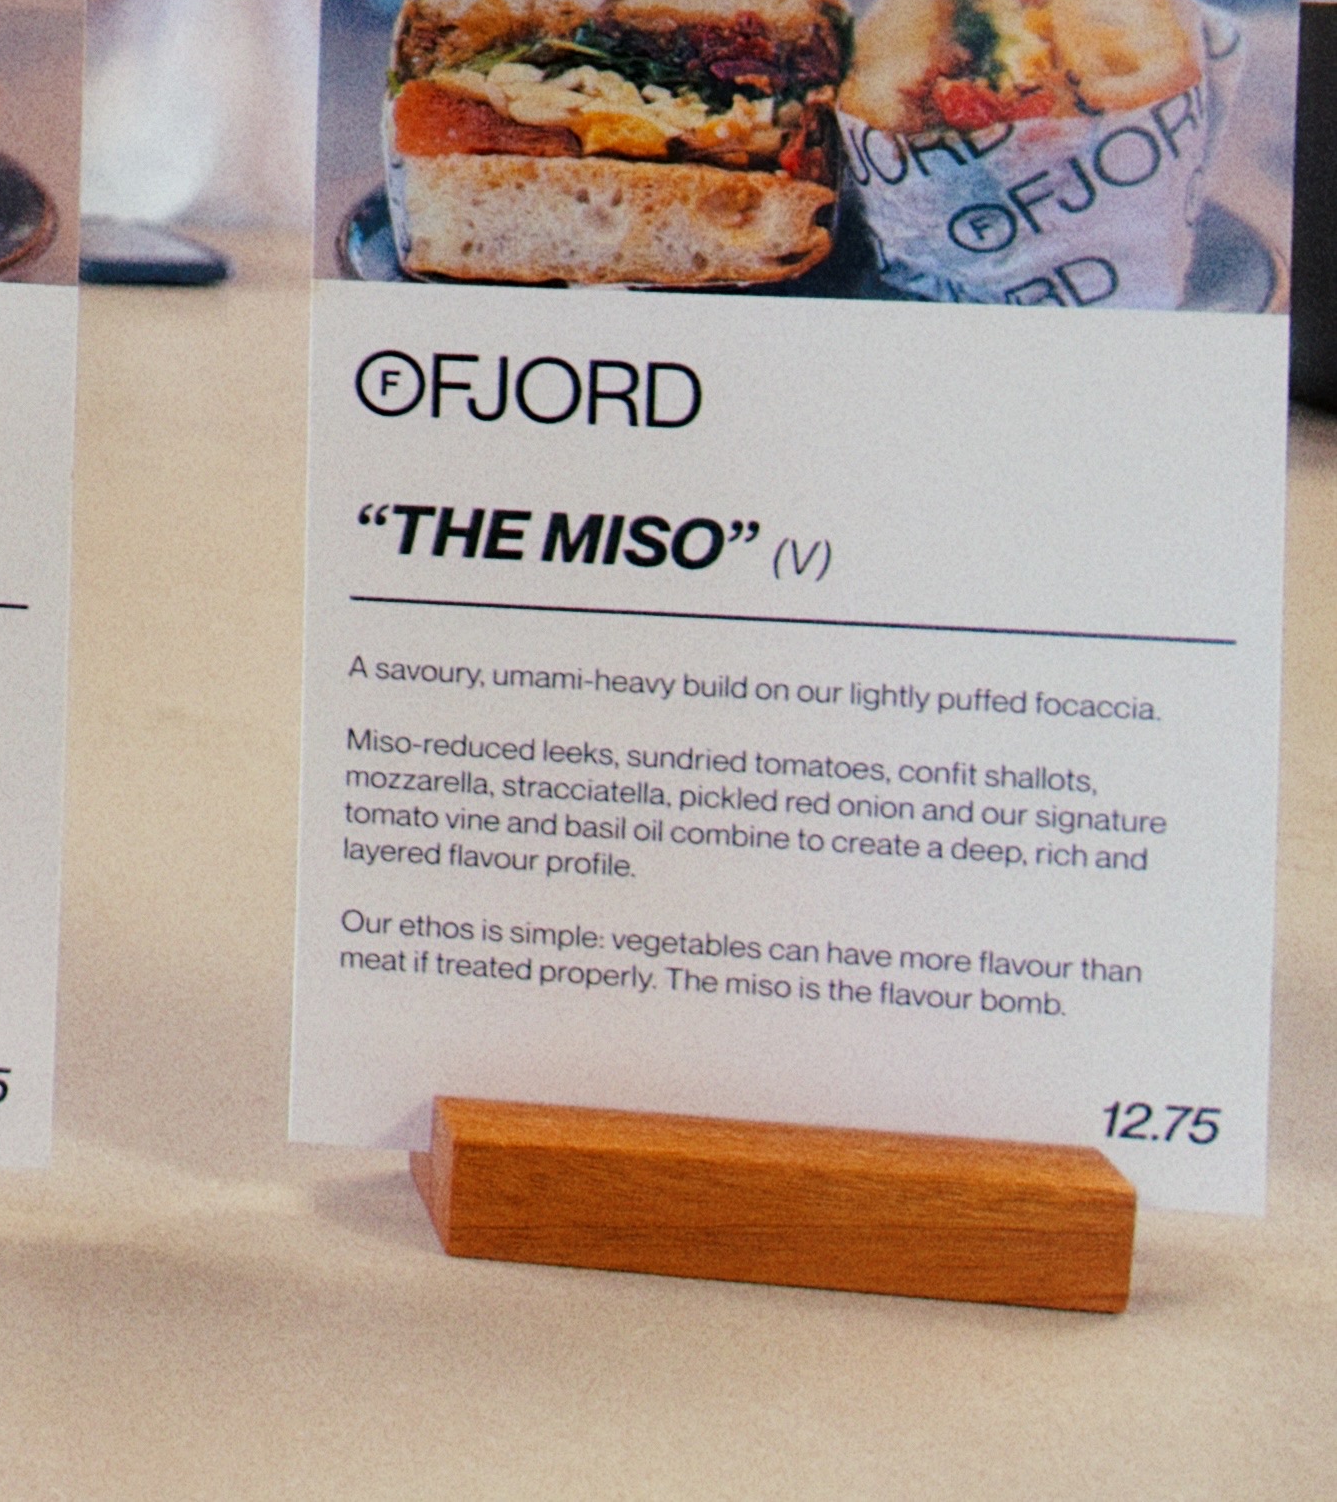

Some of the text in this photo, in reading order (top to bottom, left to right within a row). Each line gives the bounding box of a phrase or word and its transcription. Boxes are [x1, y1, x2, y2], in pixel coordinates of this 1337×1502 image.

[431, 354, 704, 430] FJORD
[357, 503, 832, 582] “THE MISO” (V)
[347, 655, 1161, 721] A savoury, umami-heavy build on our lightly puffed focaccia.
[346, 727, 1097, 796] Miso-reduced leeks, sundried tomatoes, confit shallots,
[345, 769, 1167, 835] mozzarella, stracciatella, pickled red onion and our signature
[340, 908, 1142, 983] Our ethos is simple: vegetables can have more flavour than
[1104, 1101, 1221, 1145] 12.75
